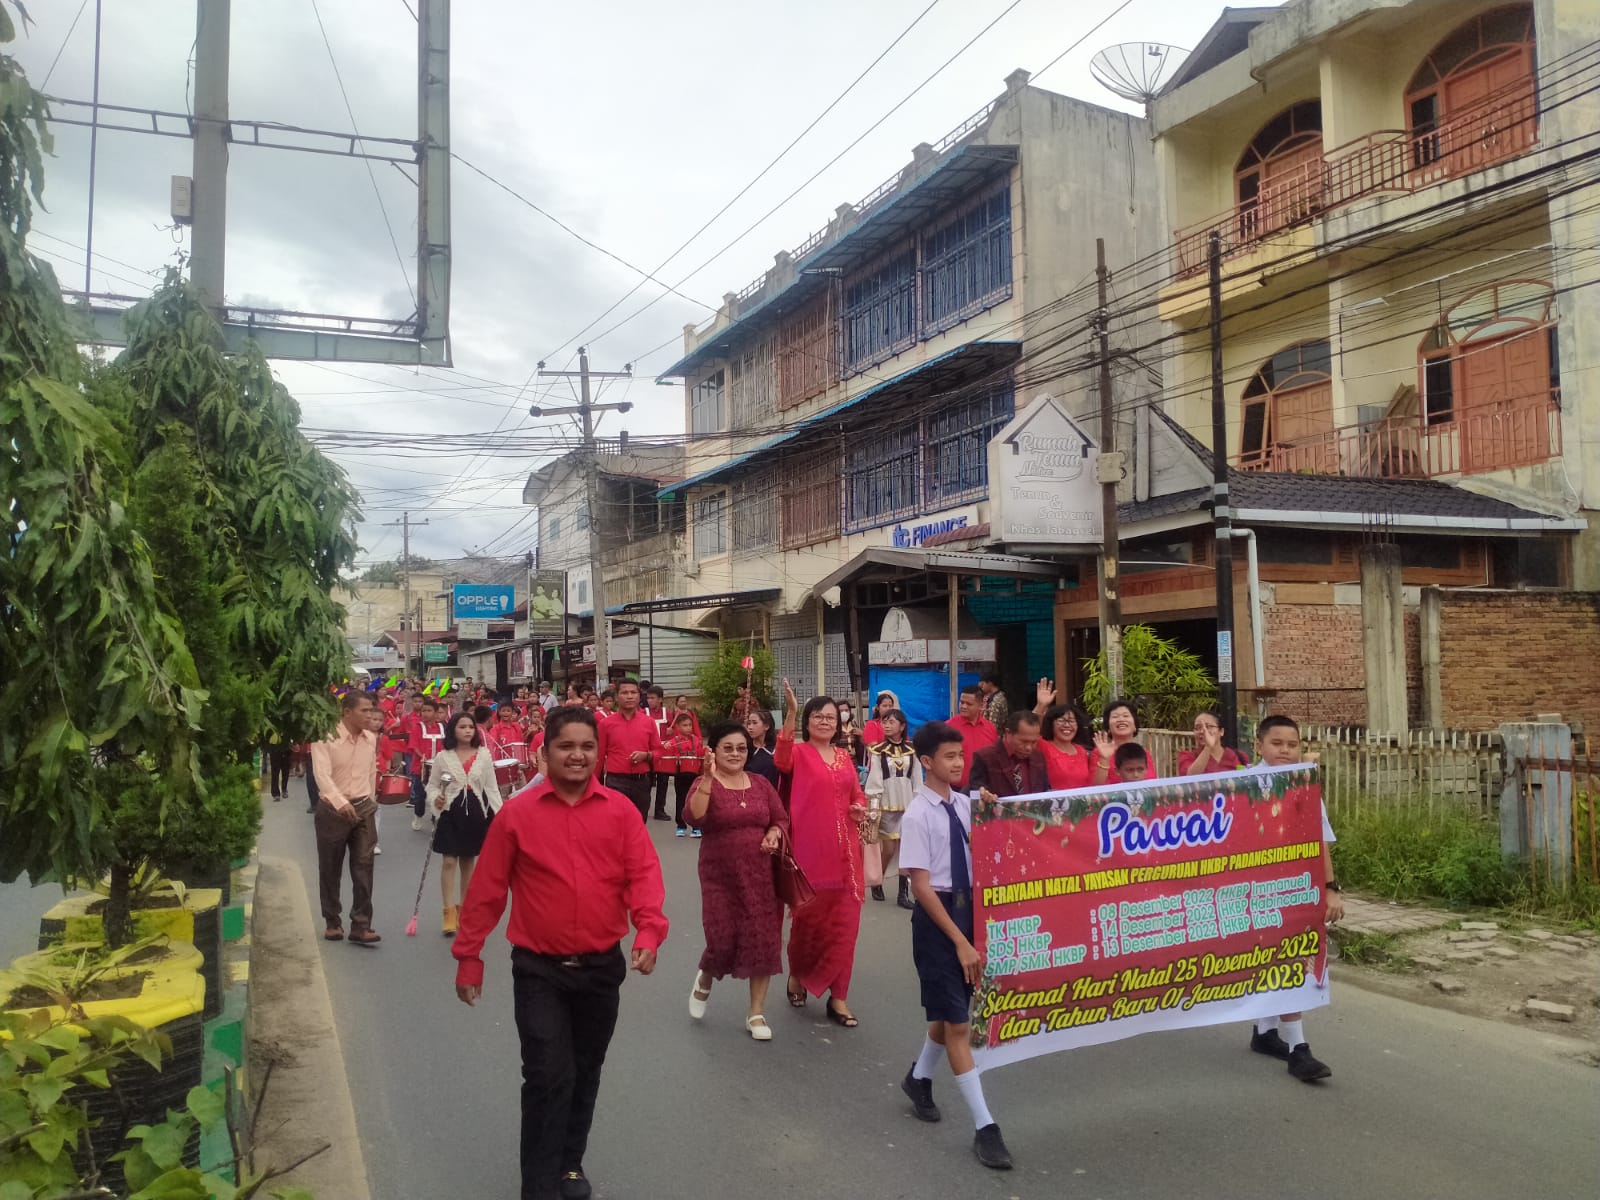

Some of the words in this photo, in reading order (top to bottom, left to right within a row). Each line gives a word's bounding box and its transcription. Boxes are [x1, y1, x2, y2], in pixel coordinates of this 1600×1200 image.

[1021, 432, 1079, 452] Rumah
[457, 595, 498, 606] OPPLE
[1099, 794, 1232, 857] Pawai
[983, 879, 1043, 907] PERAYAAN
[1045, 875, 1082, 897] NATAL
[1083, 868, 1129, 892] YAYASAN
[1131, 861, 1199, 883] PERGURUAN
[1200, 856, 1228, 876] HKBP
[1229, 841, 1320, 871] PADANGSIDEMPUAN
[988, 922, 1005, 940] TK
[1007, 916, 1041, 938] HKBP
[1099, 904, 1116, 921] 08
[1119, 896, 1181, 916] Desember
[1184, 889, 1214, 907] 2022
[1216, 882, 1249, 904] (HKBP
[1252, 872, 1311, 895] Immanuel)
[986, 952, 1051, 976] SMP/SMK
[1052, 945, 1086, 967] HKBP
[1103, 939, 1118, 957] 13
[1122, 931, 1186, 953] Desember
[1188, 922, 1218, 941] 2022
[1220, 914, 1250, 938] (HKBP
[1252, 911, 1282, 930] Kota)
[988, 939, 1014, 959] SDS
[1017, 933, 1052, 954] HKBP
[1102, 920, 1118, 939] 14
[1120, 914, 1184, 934] Desember
[1186, 906, 1215, 924] 2022
[1217, 899, 1248, 918] (HKBP
[982, 983, 1068, 1018] Selamat
[1072, 973, 1118, 1000] Hari
[1121, 963, 1173, 992] Natal
[1174, 957, 1198, 983] 25
[1202, 945, 1276, 978] Desember
[1277, 931, 1319, 960] 2022
[999, 1016, 1040, 1040] dan
[1046, 1006, 1107, 1031] Tahun
[1112, 996, 1157, 1019] Baru
[1160, 986, 1185, 1010] 01
[1183, 974, 1256, 1010] Januari
[1256, 963, 1305, 993] 2023
